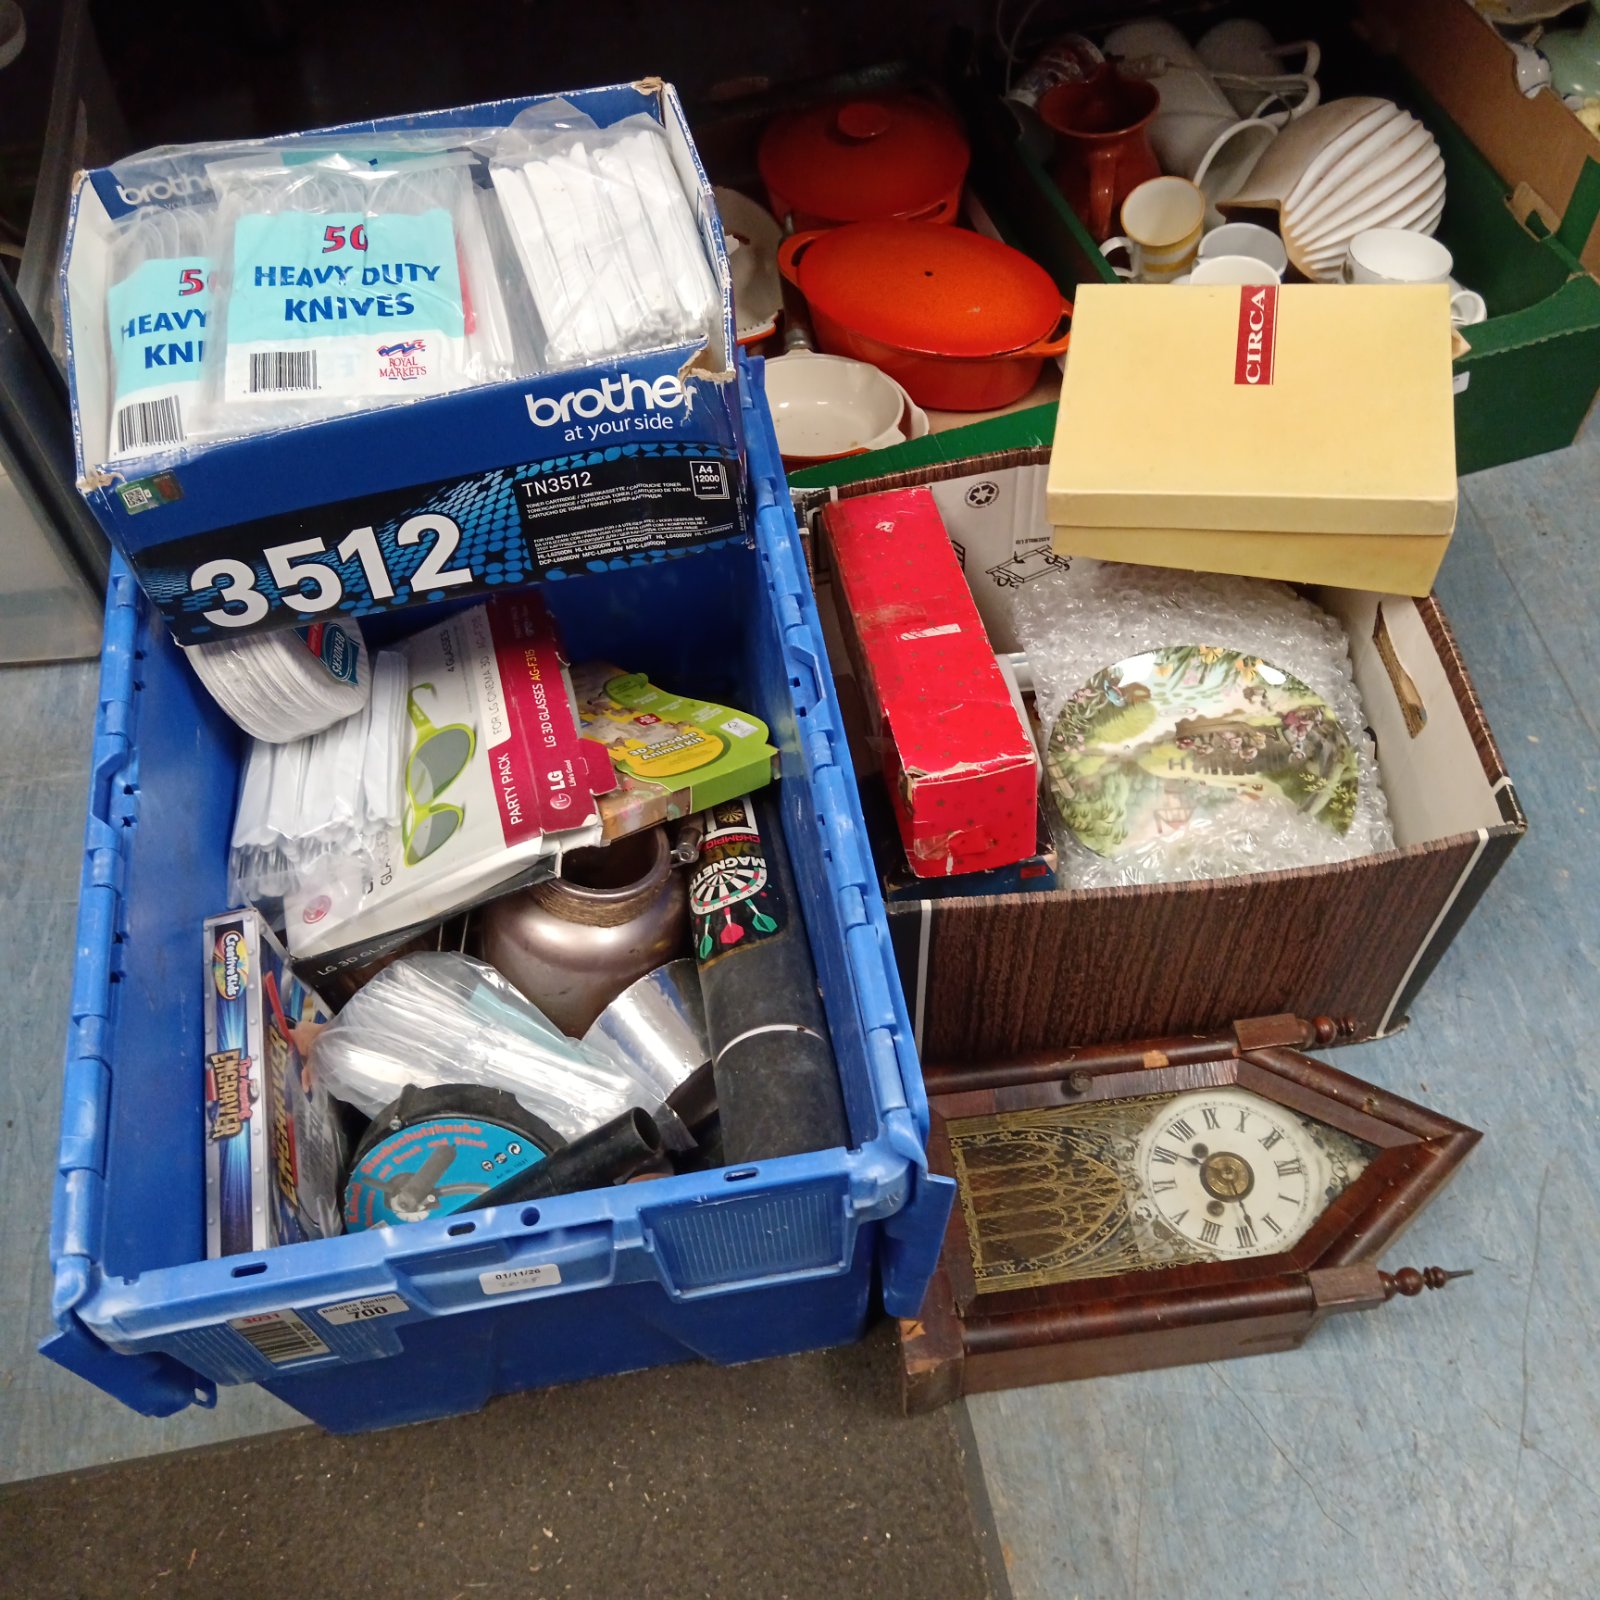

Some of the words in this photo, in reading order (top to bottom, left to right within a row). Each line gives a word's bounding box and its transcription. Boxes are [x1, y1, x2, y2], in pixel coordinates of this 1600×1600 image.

[116, 170, 211, 206] broth
[321, 223, 369, 253] 50
[255, 265, 354, 288] HEAVY
[362, 263, 441, 286] DUTY
[285, 292, 416, 322] KNIVES
[1245, 289, 1266, 384] CIRCA
[379, 365, 426, 377] MARKETS
[389, 356, 417, 367] ROYAL
[564, 427, 584, 442] at
[590, 417, 631, 442] your
[634, 413, 674, 431] side
[694, 474, 720, 483] 12000
[698, 465, 713, 474] A4
[521, 471, 593, 497] TN3512
[190, 514, 473, 627] 3512
[333, 632, 345, 676] BENDERS
[523, 648, 541, 682] AG-F315
[531, 682, 550, 721] GLASSES
[491, 715, 503, 734] FOR
[540, 720, 553, 734] 3D
[543, 733, 556, 747] LG
[628, 746, 647, 757] 3D
[647, 730, 698, 751] Wooden
[640, 742, 685, 760] Animal
[495, 752, 514, 784] PACK
[547, 769, 565, 790] LG
[503, 784, 524, 825] PARTY
[704, 834, 761, 849] CHAMPIO
[225, 934, 240, 974] Creative
[317, 964, 338, 977] LG
[338, 955, 357, 968] 3D
[226, 973, 240, 995] Kids
[210, 1051, 242, 1138] ENGRAVER
[347, 1305, 388, 1320] 700
